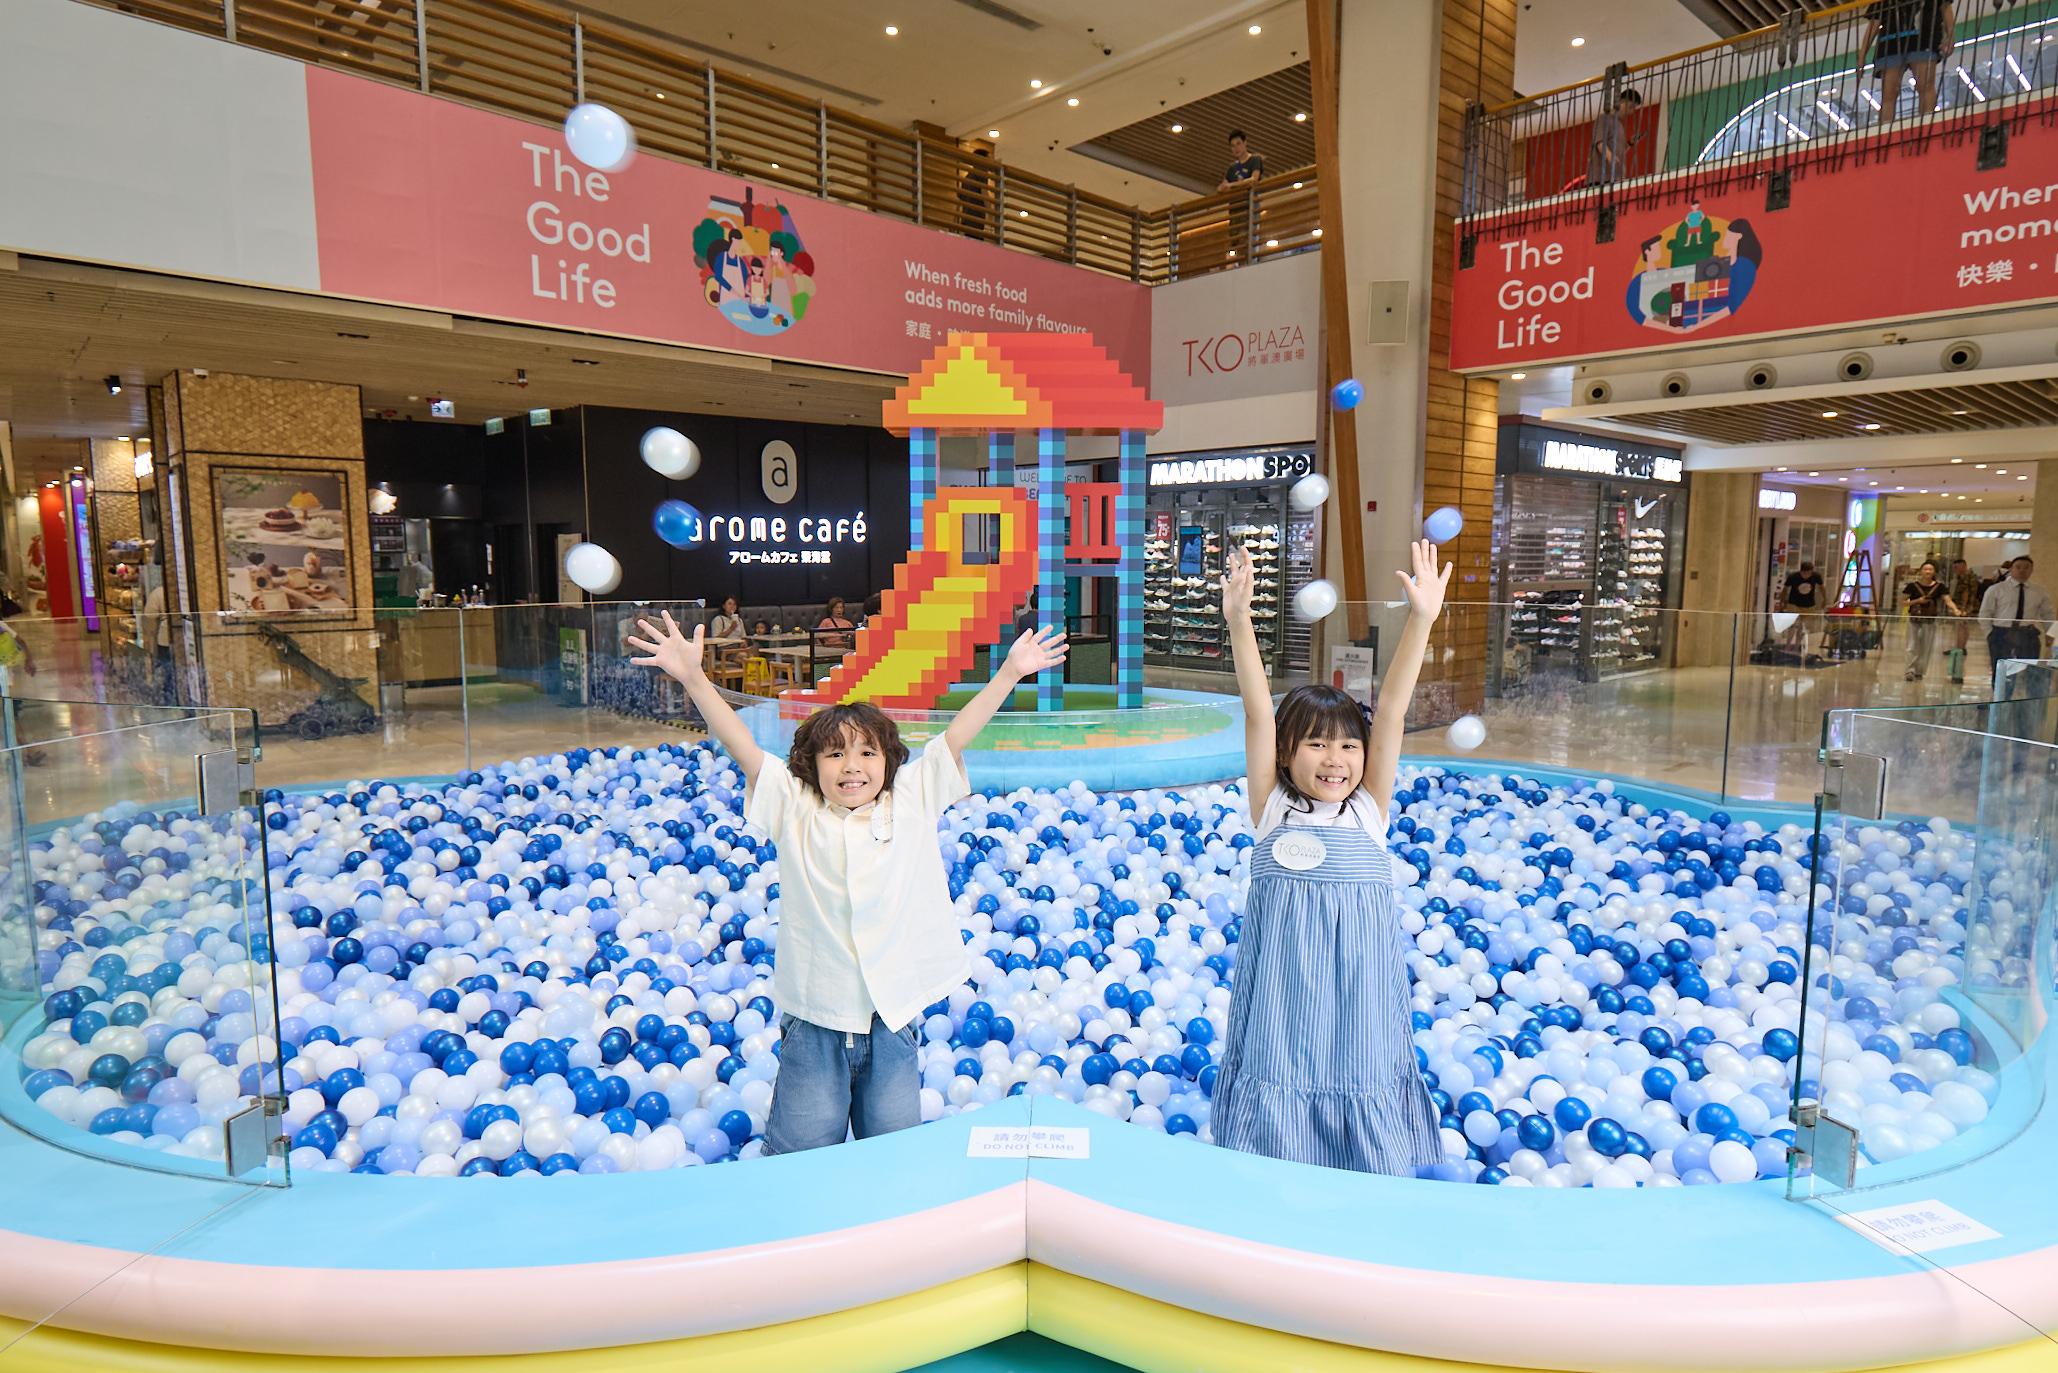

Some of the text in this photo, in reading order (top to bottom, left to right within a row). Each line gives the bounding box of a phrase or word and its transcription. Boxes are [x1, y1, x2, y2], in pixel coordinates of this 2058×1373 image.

[522, 141, 610, 202] The
[527, 201, 651, 263] Good
[1961, 219, 2058, 248] mom
[1500, 240, 1563, 272] The
[531, 254, 617, 308] Life
[904, 260, 1027, 304] When fresh food
[1498, 266, 1594, 311] Good
[904, 288, 943, 309] adds
[947, 299, 985, 317] more
[989, 303, 1033, 331] family
[1498, 314, 1561, 349] Life
[1182, 325, 1305, 376] TKO PLAZA
[798, 511, 867, 543] café
